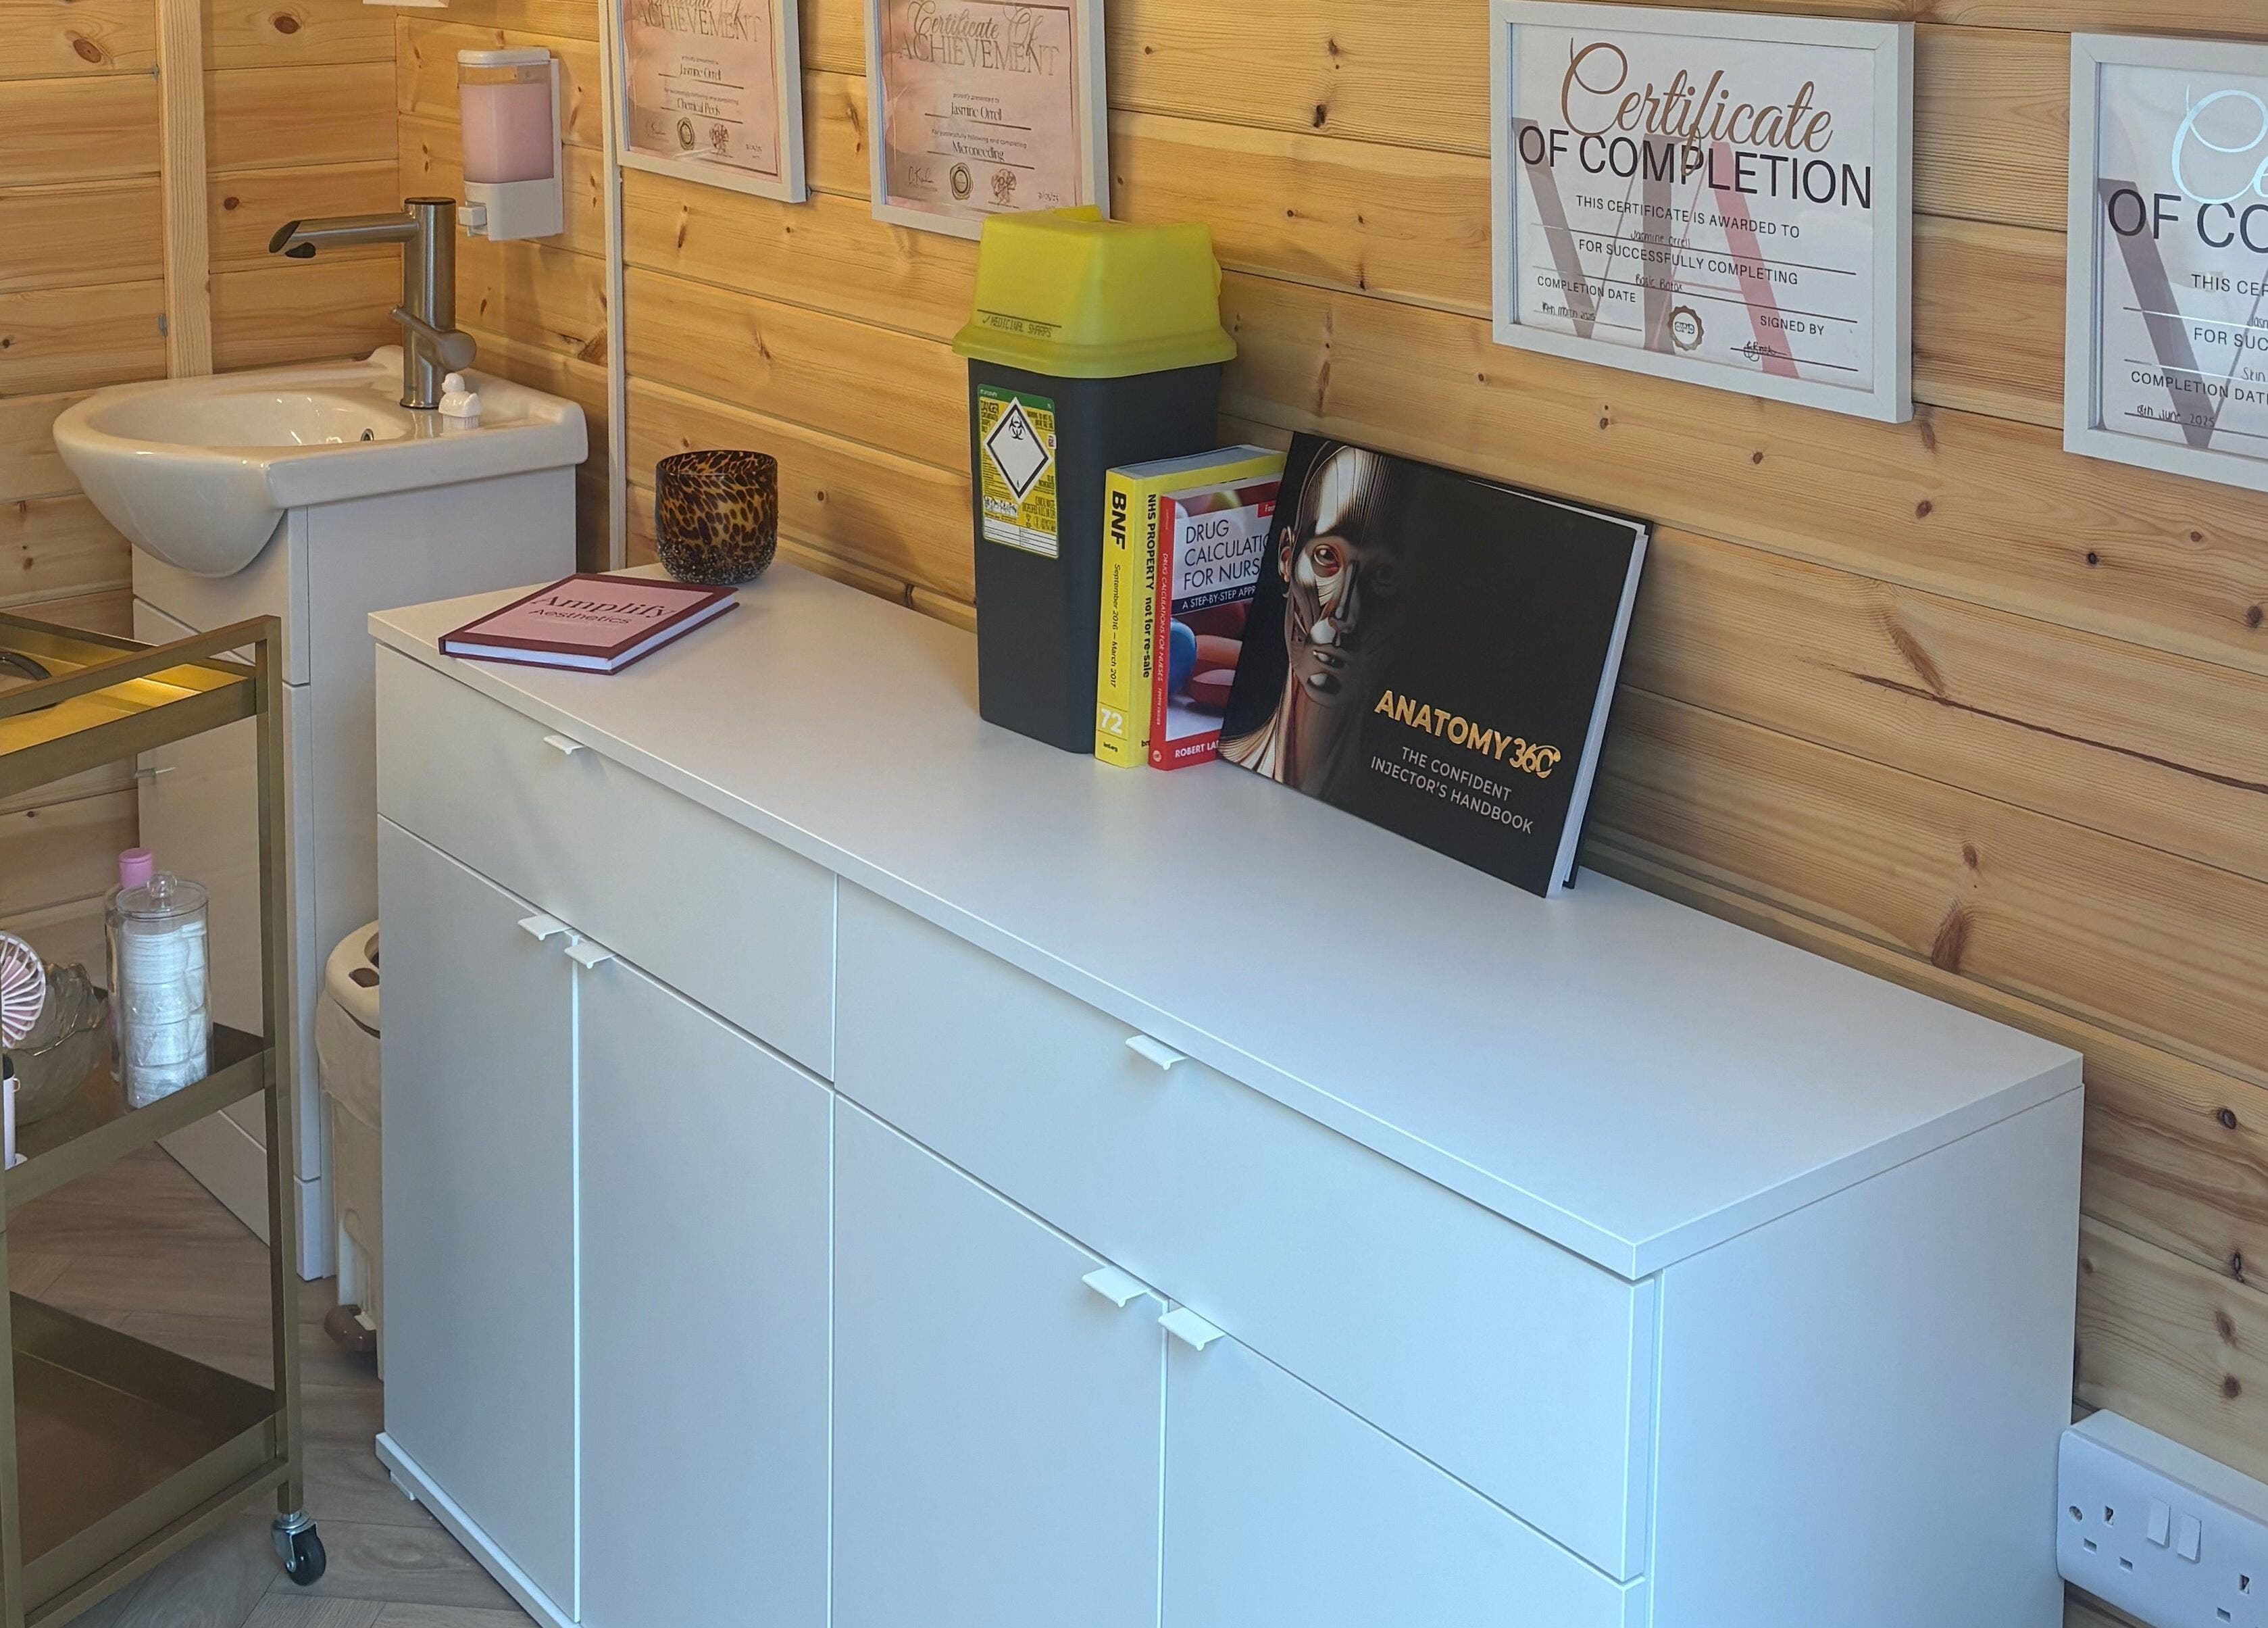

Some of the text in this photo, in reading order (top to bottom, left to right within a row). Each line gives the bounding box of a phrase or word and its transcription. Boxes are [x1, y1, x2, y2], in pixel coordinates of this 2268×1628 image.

[907, 1, 1001, 40] Certificate
[899, 31, 1059, 76] ACHIEVEMENT
[951, 101, 978, 118] Jasmine
[1561, 38, 1834, 176] Certificate
[1519, 126, 1871, 209] OF COMPLETION
[1576, 195, 1800, 239] THIS CERTIFICATE IS AWARDED TO
[2108, 189, 2182, 240] OF
[1630, 230, 1664, 243] Jasmine
[1579, 239, 1798, 285] FOR SUCCESSFULLY COMPLETING
[1537, 276, 1636, 303] COMPLETION DATE
[2191, 274, 2230, 292] THIS
[1760, 316, 1825, 336] SIGNED BY
[2194, 328, 2227, 345] FOR
[2131, 371, 2268, 405] COMPLETION DAT
[2241, 366, 2266, 382] Skin
[1110, 490, 1128, 549] BNF
[1147, 493, 1157, 520] NHS
[1186, 519, 1229, 544] DRUG
[1146, 523, 1156, 590] PROPERTY
[1184, 558, 1260, 591] FOR NURS
[530, 596, 676, 618] Amplify
[1159, 577, 1168, 634] CALCULATIONS
[1182, 601, 1189, 610] A
[1190, 590, 1237, 608] STEP-BY-STEP
[528, 609, 632, 624] Aesthetics
[1144, 618, 1153, 635] for
[1143, 637, 1153, 679] re-sale
[1100, 707, 1124, 735] 72
[1174, 745, 1205, 758] ROBERT
[1402, 745, 1513, 801] THE CONFIDENT
[1370, 756, 1535, 835] INJECTOR'S HANDBOOK
